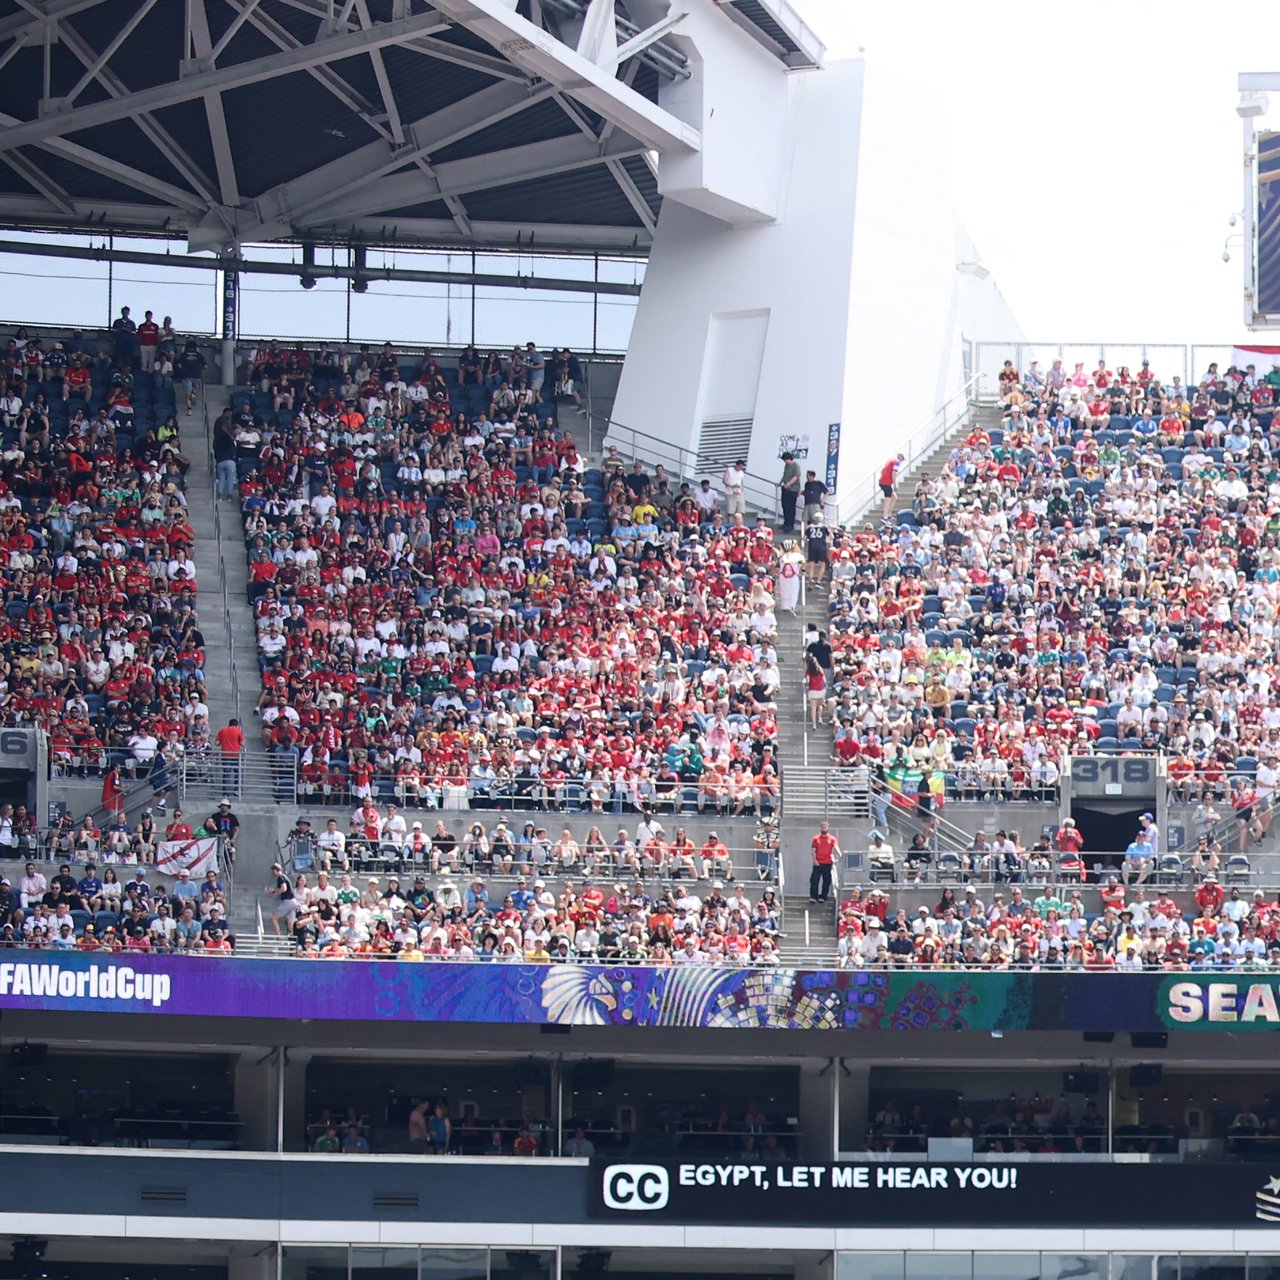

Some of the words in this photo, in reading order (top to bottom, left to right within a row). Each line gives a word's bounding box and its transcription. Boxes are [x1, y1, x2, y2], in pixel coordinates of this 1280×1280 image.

[1072, 760, 1150, 782] 318
[609, 1171, 662, 1204] CC
[679, 1164, 768, 1191] EGYPT,
[776, 1165, 825, 1188] LET
[832, 1166, 870, 1188] ME
[877, 1167, 948, 1189] HEAR
[953, 1167, 1018, 1189] YOU!
